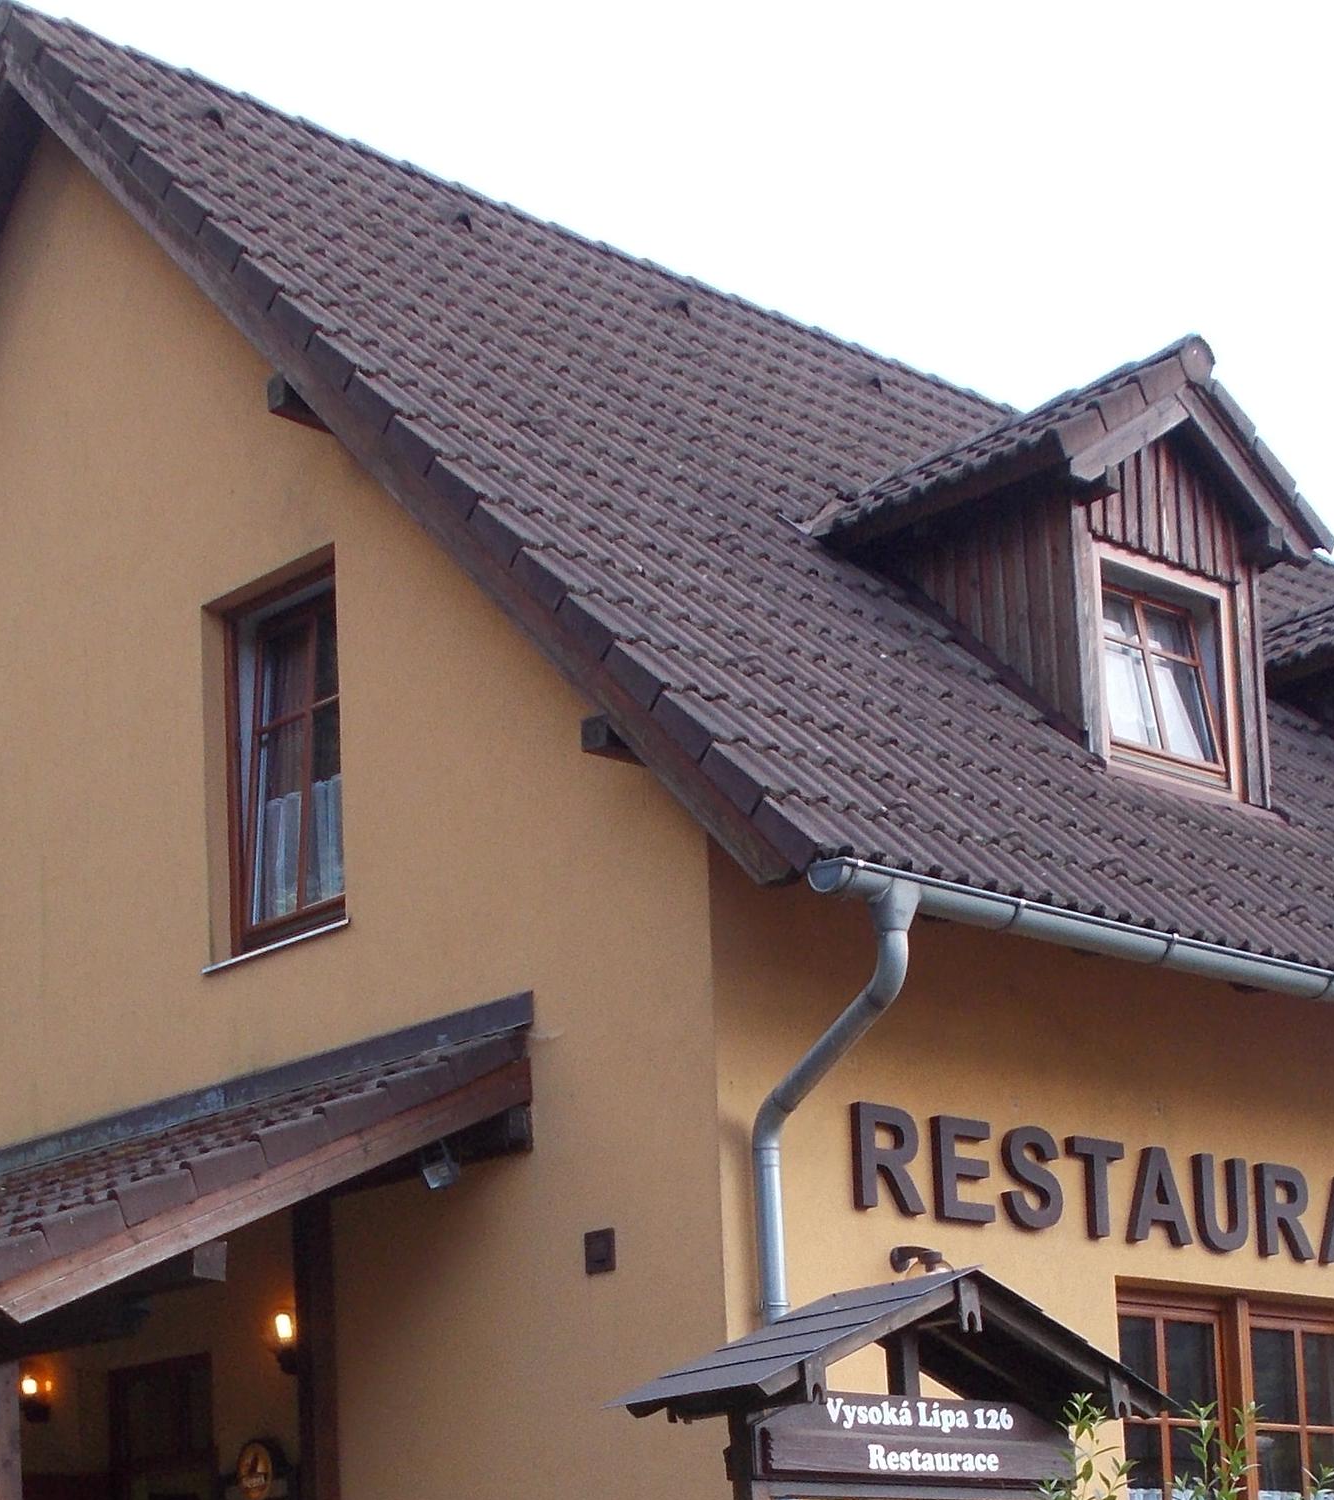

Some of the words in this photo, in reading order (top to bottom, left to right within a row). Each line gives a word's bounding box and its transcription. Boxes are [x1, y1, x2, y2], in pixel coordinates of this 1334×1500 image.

[826, 1397, 913, 1429] Vysoká
[917, 1401, 969, 1433] Lípa
[974, 1408, 1014, 1430] 126
[867, 1444, 1000, 1472] Restaurace
